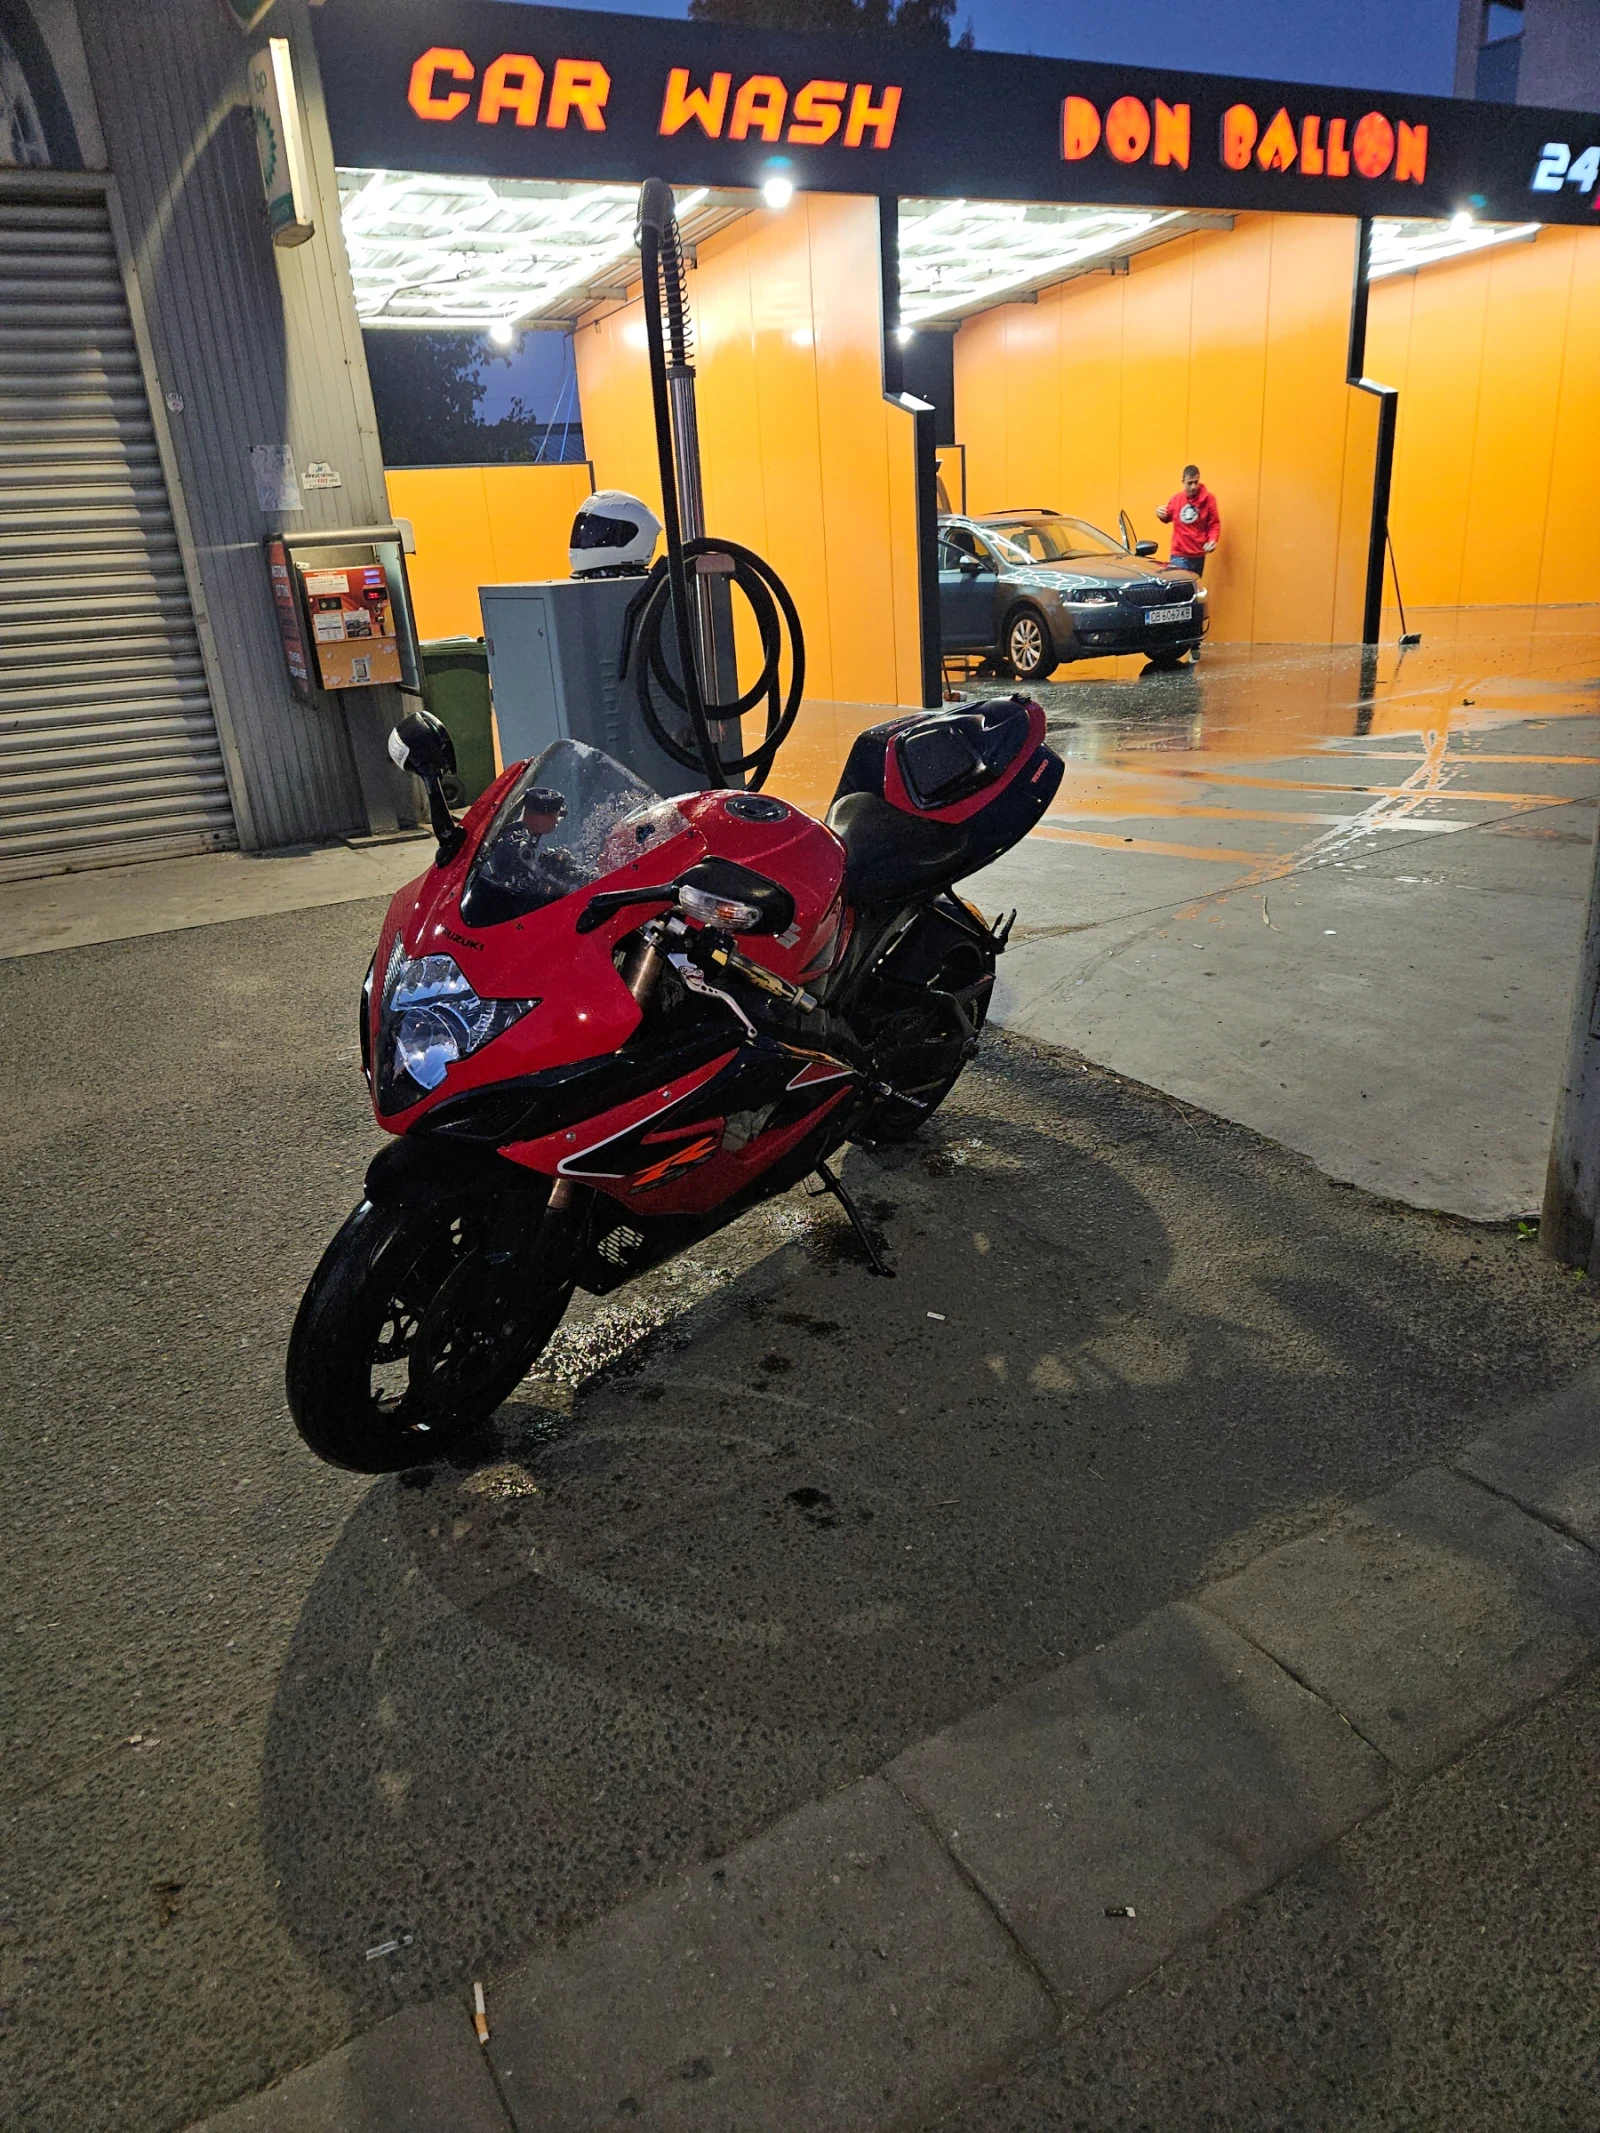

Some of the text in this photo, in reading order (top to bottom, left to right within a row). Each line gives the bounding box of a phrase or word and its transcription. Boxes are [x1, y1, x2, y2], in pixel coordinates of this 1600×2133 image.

[253, 69, 268, 97] bp
[408, 47, 904, 149] CAR WASH
[1061, 95, 1430, 184] DON BALLON
